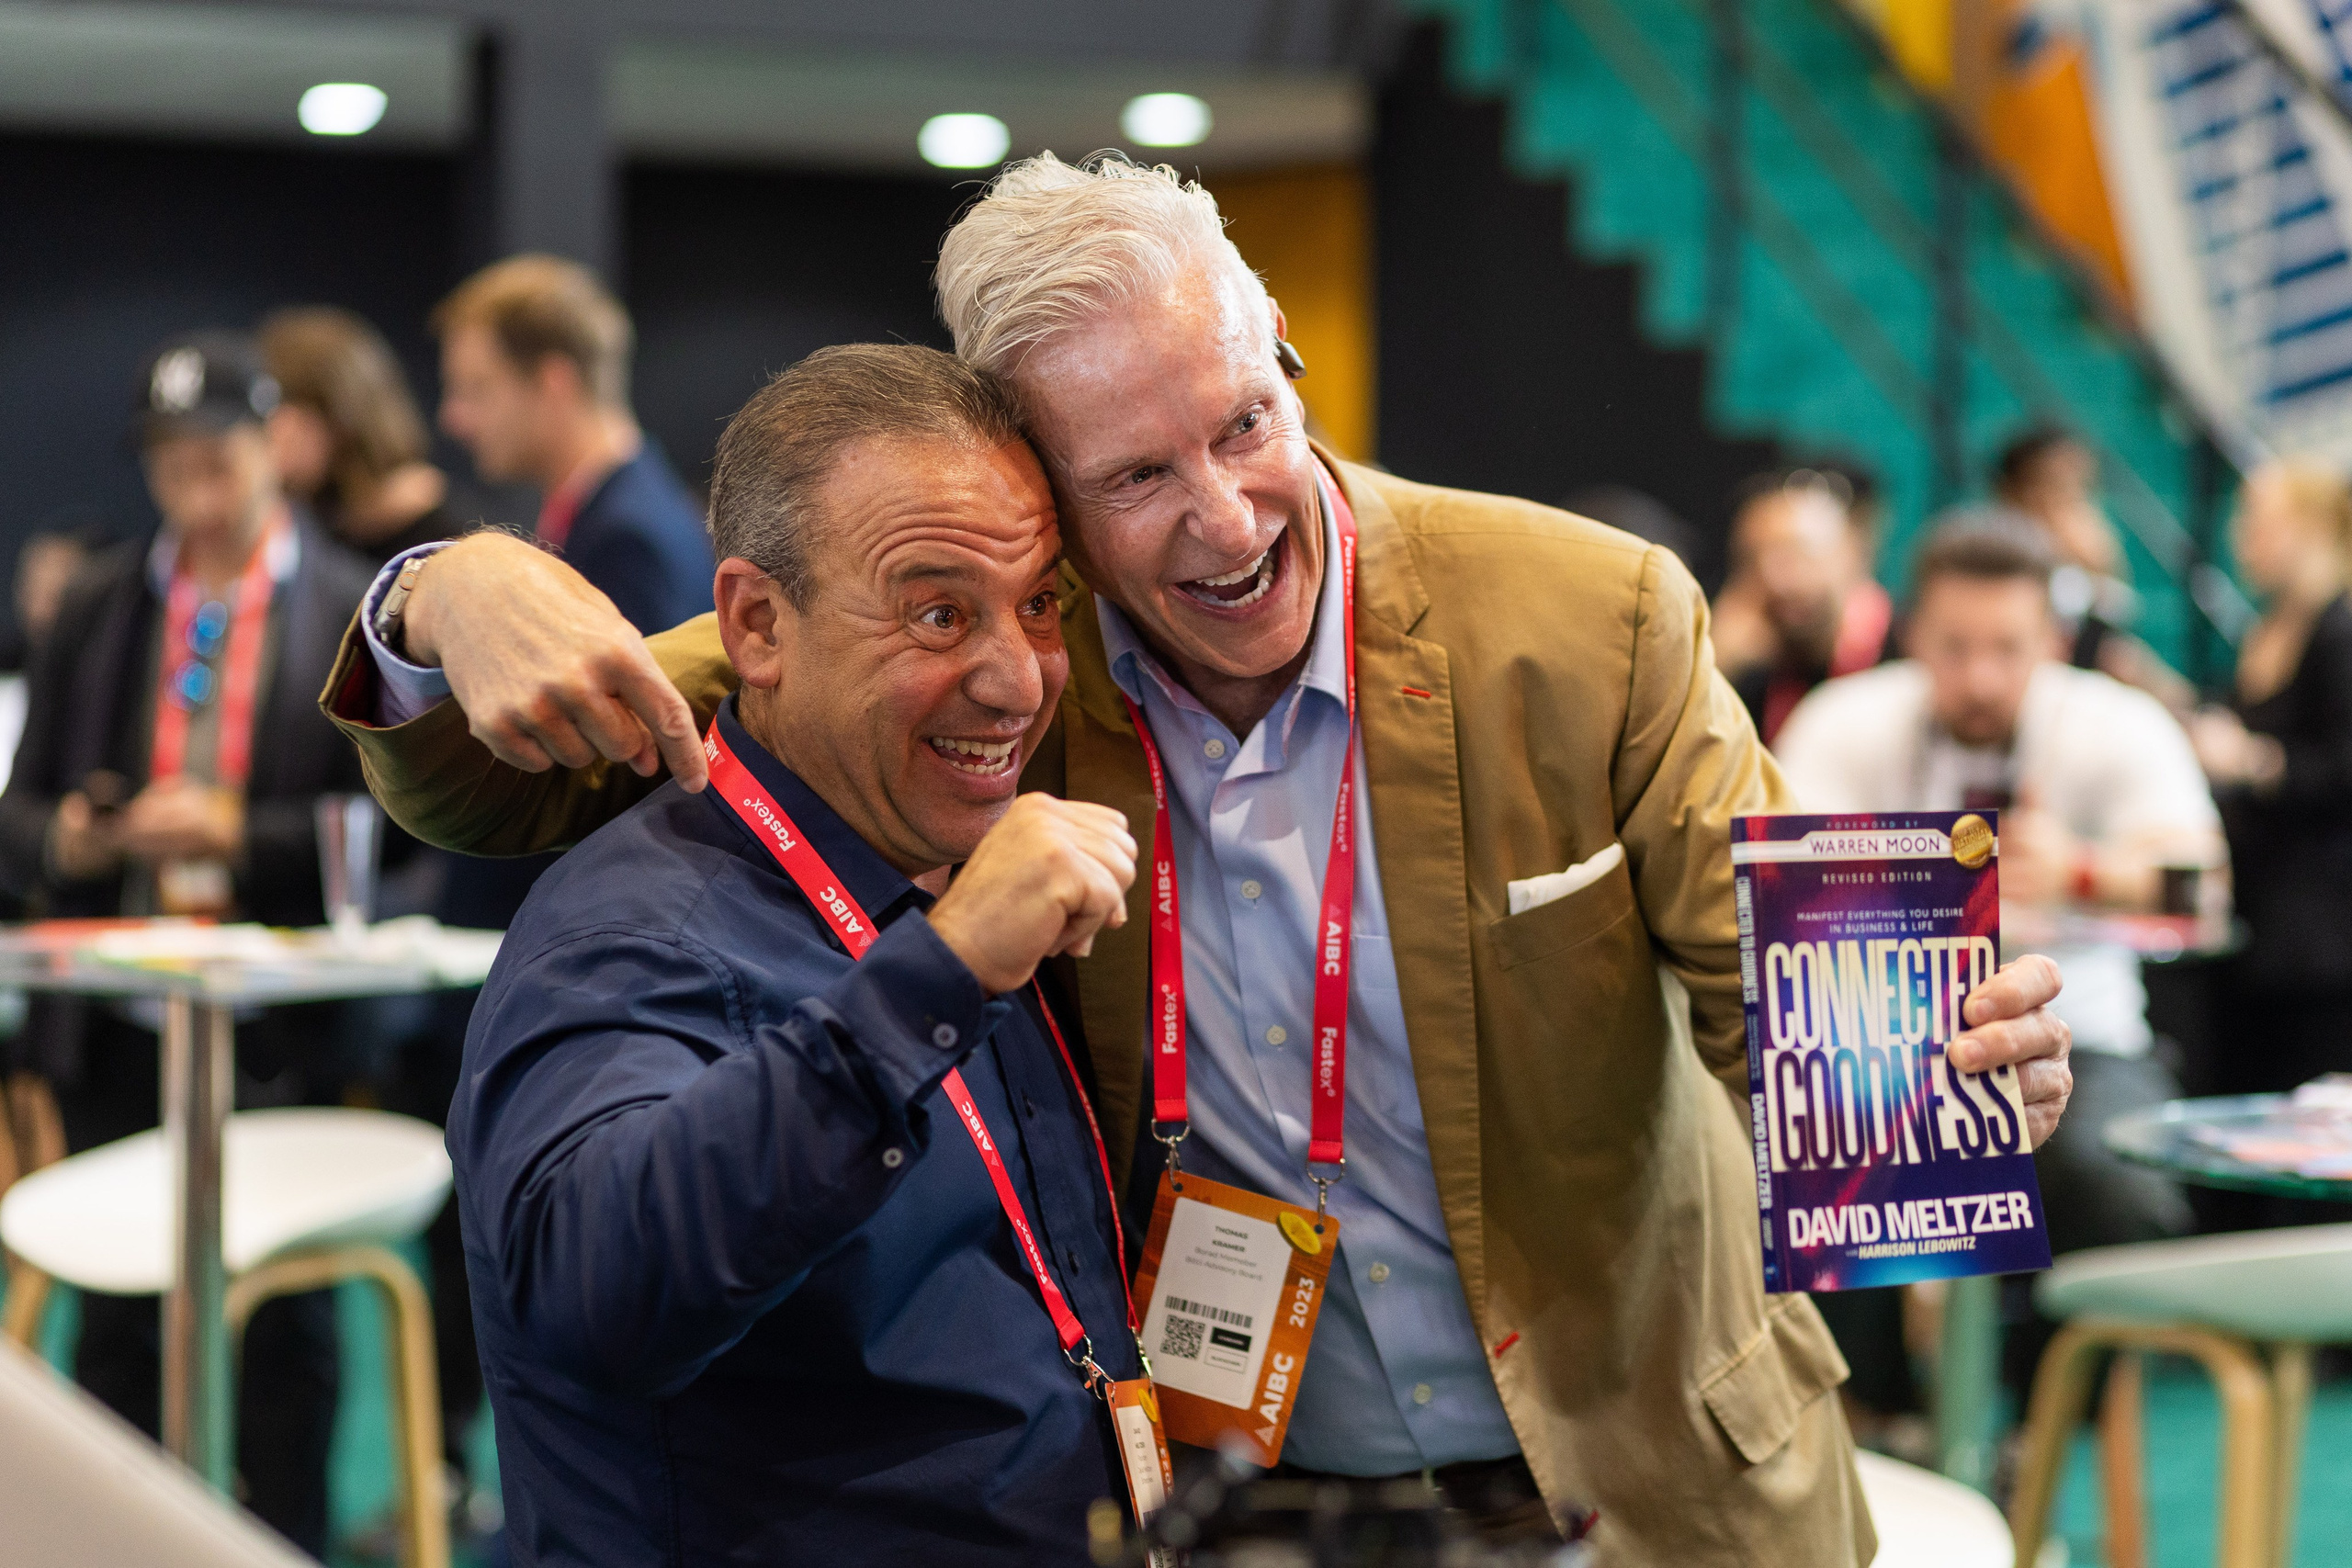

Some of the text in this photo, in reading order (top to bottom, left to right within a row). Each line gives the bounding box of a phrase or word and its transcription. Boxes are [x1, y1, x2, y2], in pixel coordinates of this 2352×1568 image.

[1810, 837, 1879, 854] WARREN
[1886, 836, 1940, 852] MOON
[1905, 818, 1918, 829] BY
[1157, 860, 1173, 915] AIBC
[1822, 871, 1931, 885] REVISED EDITION
[820, 886, 864, 934] AIBC
[1797, 907, 1964, 921] MANIFEST EVERYTHING YOU DESIRE
[1829, 920, 1934, 934] IN BUSINESS & LIFE
[1324, 920, 1341, 976] AIBC
[962, 1100, 993, 1152] AIBC
[1751, 1093, 1765, 1141] DAVID
[1755, 1142, 1772, 1210] MELTZER
[1216, 1225, 1249, 1239] THOMAS
[1788, 1204, 1882, 1248] DAVID
[1884, 1191, 2034, 1241] MELTZER
[1212, 1239, 1245, 1252] KRAMER
[1859, 1241, 1917, 1259] HARRISON
[1917, 1235, 1976, 1255] LEBOWITZ
[1289, 1277, 1315, 1328] 2023
[1260, 1352, 1294, 1424] AIBC
